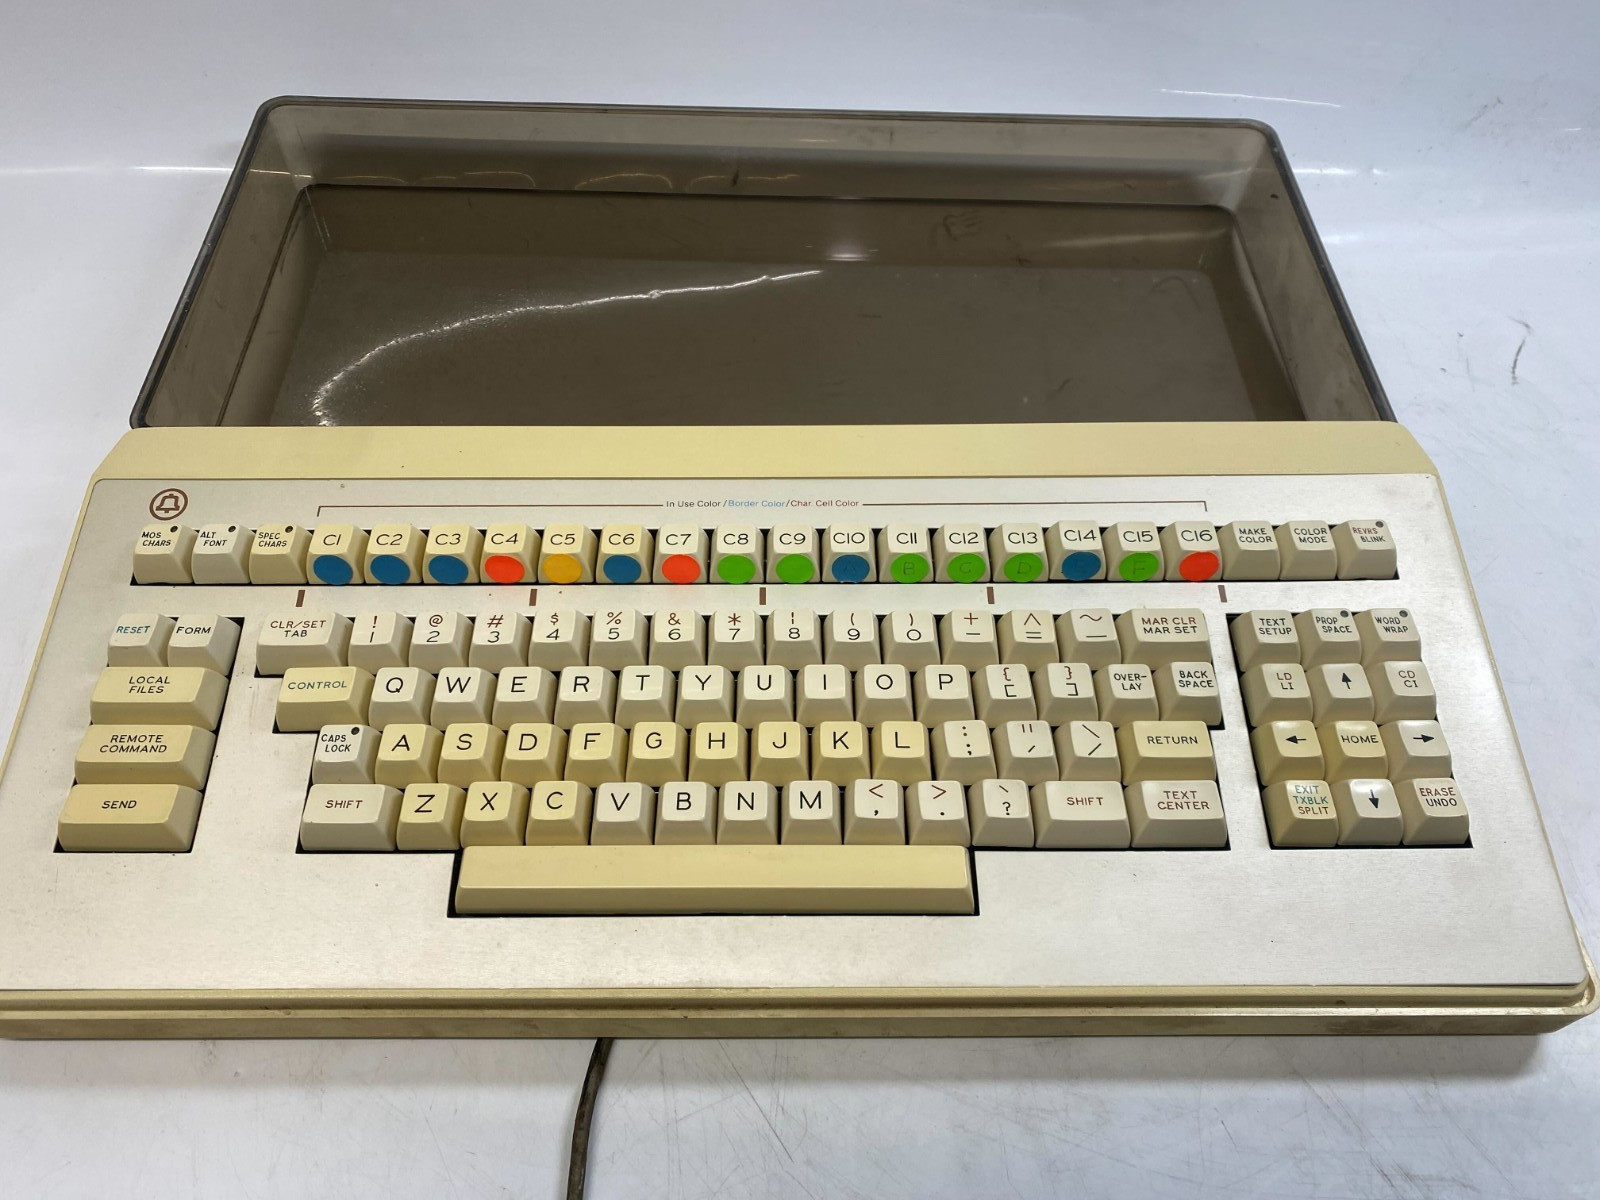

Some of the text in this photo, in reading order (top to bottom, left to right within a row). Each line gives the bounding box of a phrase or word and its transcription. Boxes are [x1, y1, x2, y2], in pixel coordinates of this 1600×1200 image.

[666, 500, 675, 508] In
[677, 500, 695, 508] Use
[697, 500, 721, 508] Color
[815, 499, 833, 507] Cell
[835, 499, 859, 507] Color
[141, 531, 162, 539] MOS
[200, 531, 217, 539] ALT
[257, 531, 281, 540] SPEC
[1352, 527, 1379, 535] REVRS
[142, 539, 171, 547] CHARS
[203, 539, 228, 547] FONT
[258, 539, 288, 548] CHARS
[375, 533, 403, 546] C2
[434, 533, 461, 546] C3
[490, 533, 519, 545] C4
[550, 533, 576, 546] C5
[608, 533, 635, 546] C6
[665, 533, 692, 546] C7
[722, 533, 749, 545] C8
[779, 533, 806, 545] C9
[270, 620, 327, 629] CLR/SET
[428, 614, 444, 628] @
[486, 614, 504, 629] #
[550, 612, 559, 626] $
[667, 612, 681, 626] &
[1141, 617, 1197, 625] MAR CLR
[1259, 618, 1286, 626] TEXT
[1315, 616, 1338, 625] PROP
[1374, 616, 1401, 625] WORD
[115, 625, 151, 634] RESET
[175, 626, 212, 635] FORM
[284, 630, 308, 638] TAB
[545, 629, 560, 641] 4
[608, 628, 620, 640] 5
[668, 628, 681, 640] 6
[728, 628, 741, 641] 7
[788, 627, 801, 639] 8
[846, 628, 861, 641] 9
[1143, 625, 1198, 634] MAR SET
[1258, 627, 1292, 635] SETUP
[1321, 625, 1353, 633] SPACE
[1383, 625, 1409, 633] WRAP
[426, 630, 441, 643] 2
[487, 630, 500, 643] 3
[128, 676, 171, 685] LOCAL
[1113, 672, 1148, 682] OVER-
[1179, 670, 1208, 679] BACK
[1276, 672, 1292, 681] LD
[1398, 670, 1416, 679] CD
[287, 680, 348, 690] CONTROL
[385, 676, 404, 694] Q
[445, 676, 472, 694] W
[510, 676, 528, 693] E
[572, 675, 591, 693] R
[635, 674, 650, 691] T
[694, 674, 712, 691] Y
[757, 674, 772, 691] U
[875, 674, 894, 690] O
[938, 673, 954, 690] P
[1121, 682, 1142, 692] LAY
[1178, 679, 1215, 689] SPACE
[128, 685, 165, 694] FILES
[110, 734, 164, 743] REMOTE
[320, 734, 347, 743] CAPS
[391, 734, 411, 752] A
[456, 733, 473, 751] S
[518, 733, 538, 751] D
[583, 732, 602, 750] F
[645, 732, 663, 749] G
[707, 732, 726, 749] H
[772, 731, 787, 749] J
[832, 731, 850, 749] K
[895, 731, 911, 749] L
[1146, 735, 1198, 745] RETURN
[1341, 734, 1379, 744] HOME
[99, 744, 168, 753] COMMAND
[324, 743, 352, 753] LOCK
[1163, 790, 1197, 800] TEXT
[1294, 785, 1320, 794] EXIT
[1419, 787, 1457, 797] ERASE
[101, 800, 137, 809] SEND
[325, 799, 363, 809] SHIFT
[414, 794, 436, 813] Z
[480, 792, 498, 811] X
[546, 791, 564, 810] C
[610, 792, 630, 811] V
[676, 792, 692, 811] B
[737, 791, 754, 811] N
[799, 790, 822, 810] M
[1066, 797, 1104, 806] SHIFT
[1157, 800, 1210, 810] CENTER
[1292, 795, 1329, 805] TXBLK
[1425, 798, 1458, 807] UNDO
[1002, 801, 1012, 816] ?
[1298, 806, 1330, 815] SPLIT
